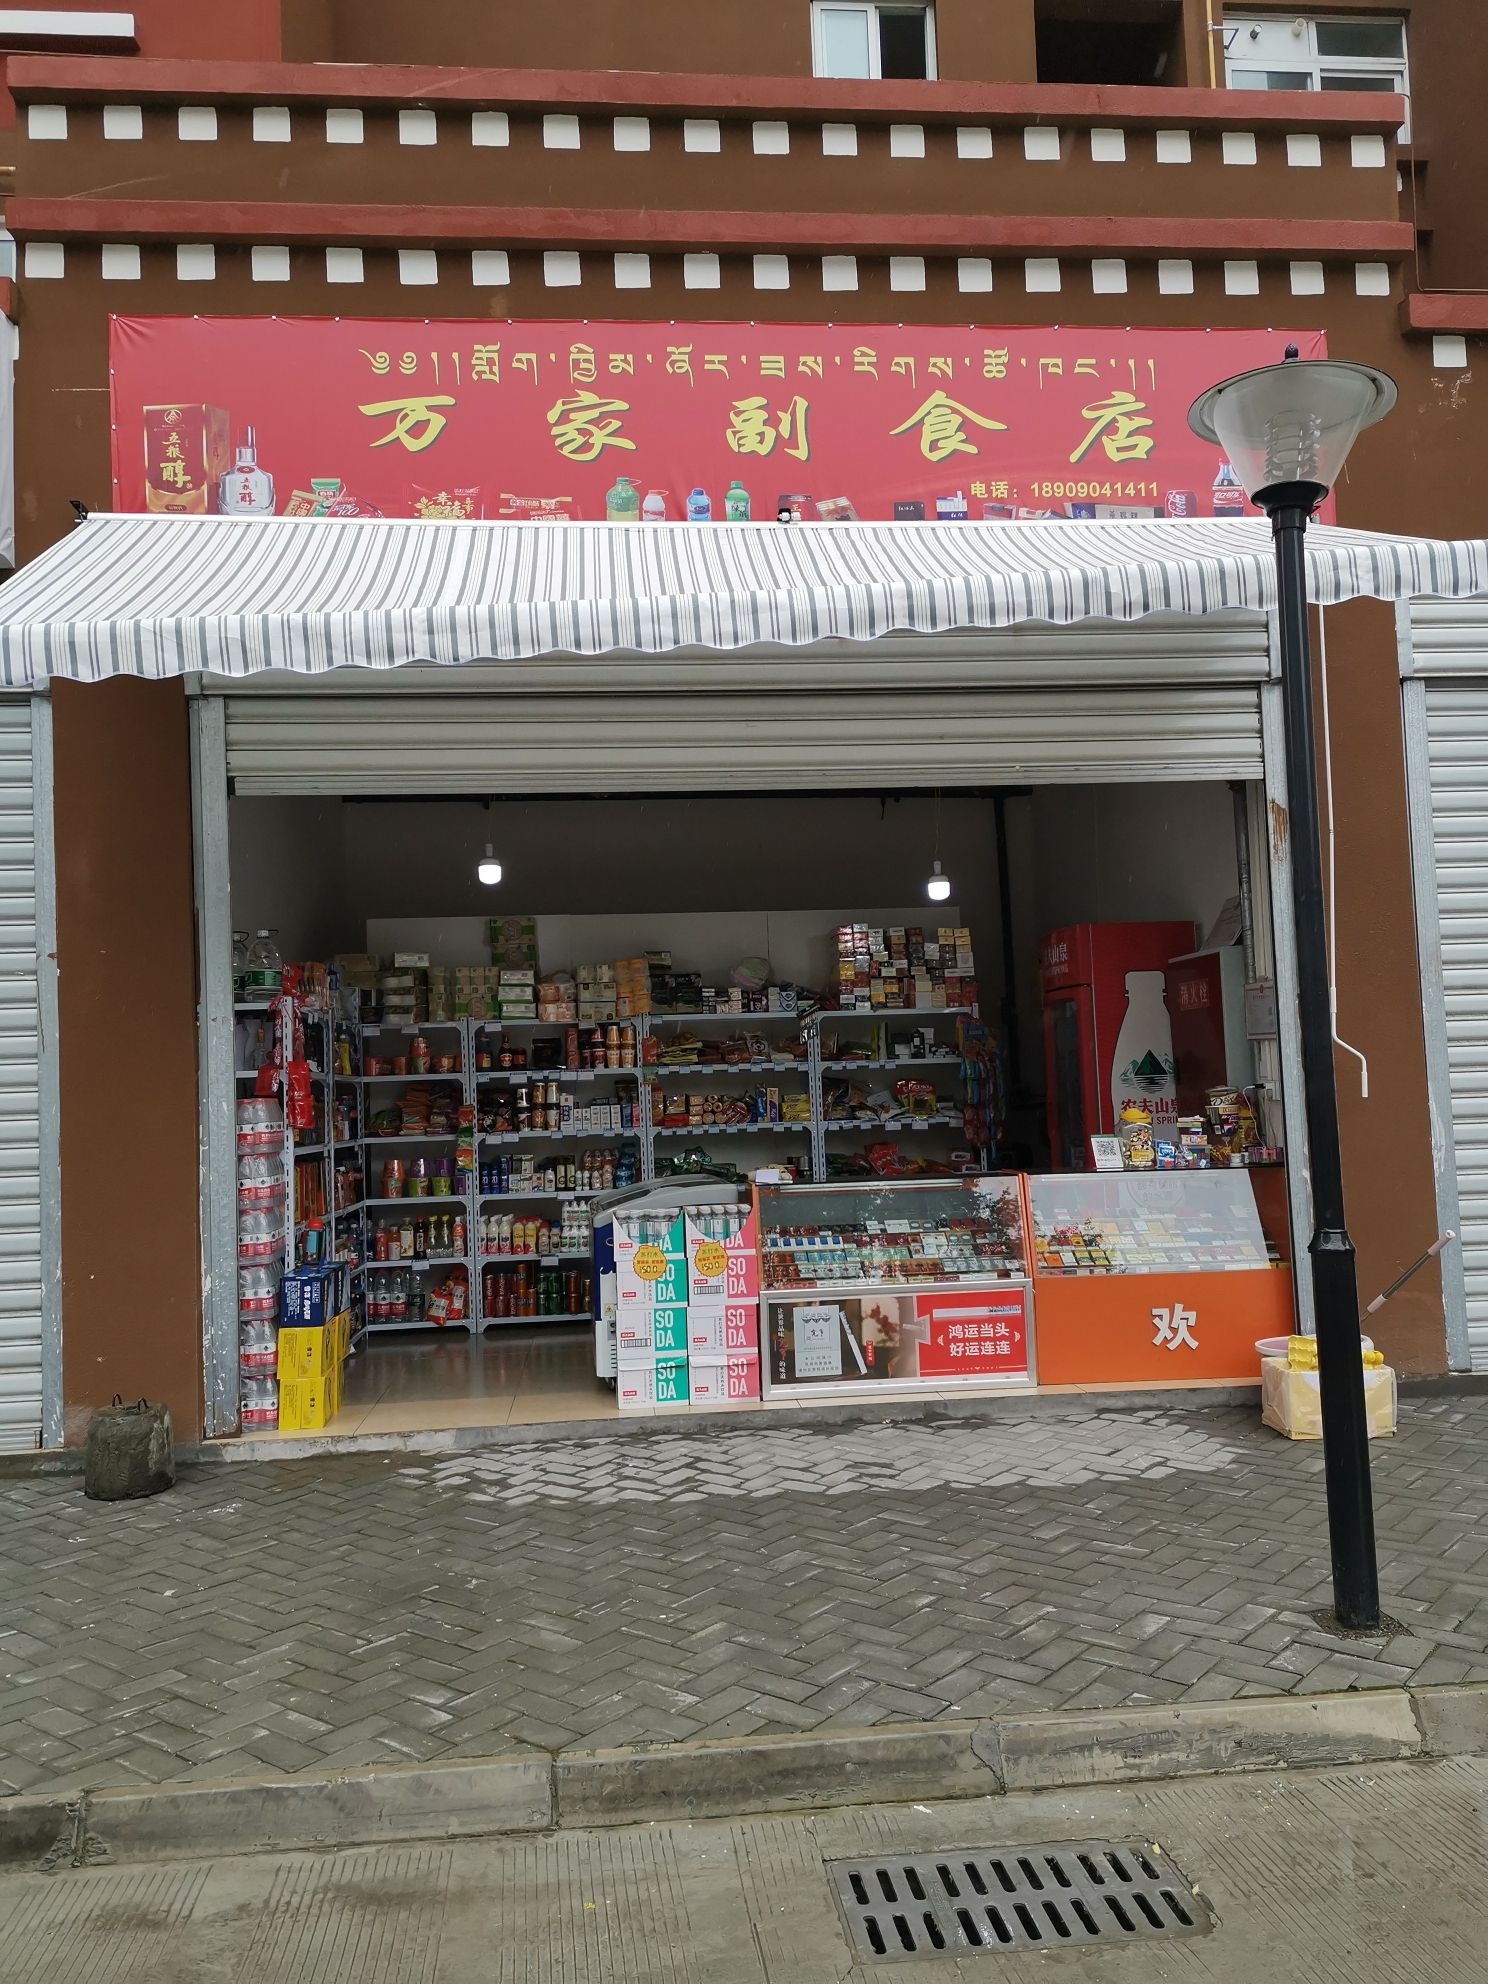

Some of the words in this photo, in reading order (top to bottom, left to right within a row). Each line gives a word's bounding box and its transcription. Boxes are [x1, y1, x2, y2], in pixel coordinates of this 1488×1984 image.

[358, 388, 1154, 464] 万家副食店
[728, 1258, 746, 1276] SO
[657, 1283, 676, 1301] DA
[729, 1277, 747, 1295] DA
[655, 1310, 674, 1328] SO
[727, 1308, 745, 1327] SO
[948, 1323, 1010, 1340] 鸿运当头
[1151, 1303, 1200, 1351] 欢
[656, 1330, 675, 1348] DA
[728, 1327, 747, 1346] DA
[949, 1340, 1011, 1357] 好运连连
[657, 1361, 676, 1380] SO
[729, 1357, 748, 1376] SO
[658, 1381, 677, 1399] DA
[730, 1377, 749, 1396] DA
